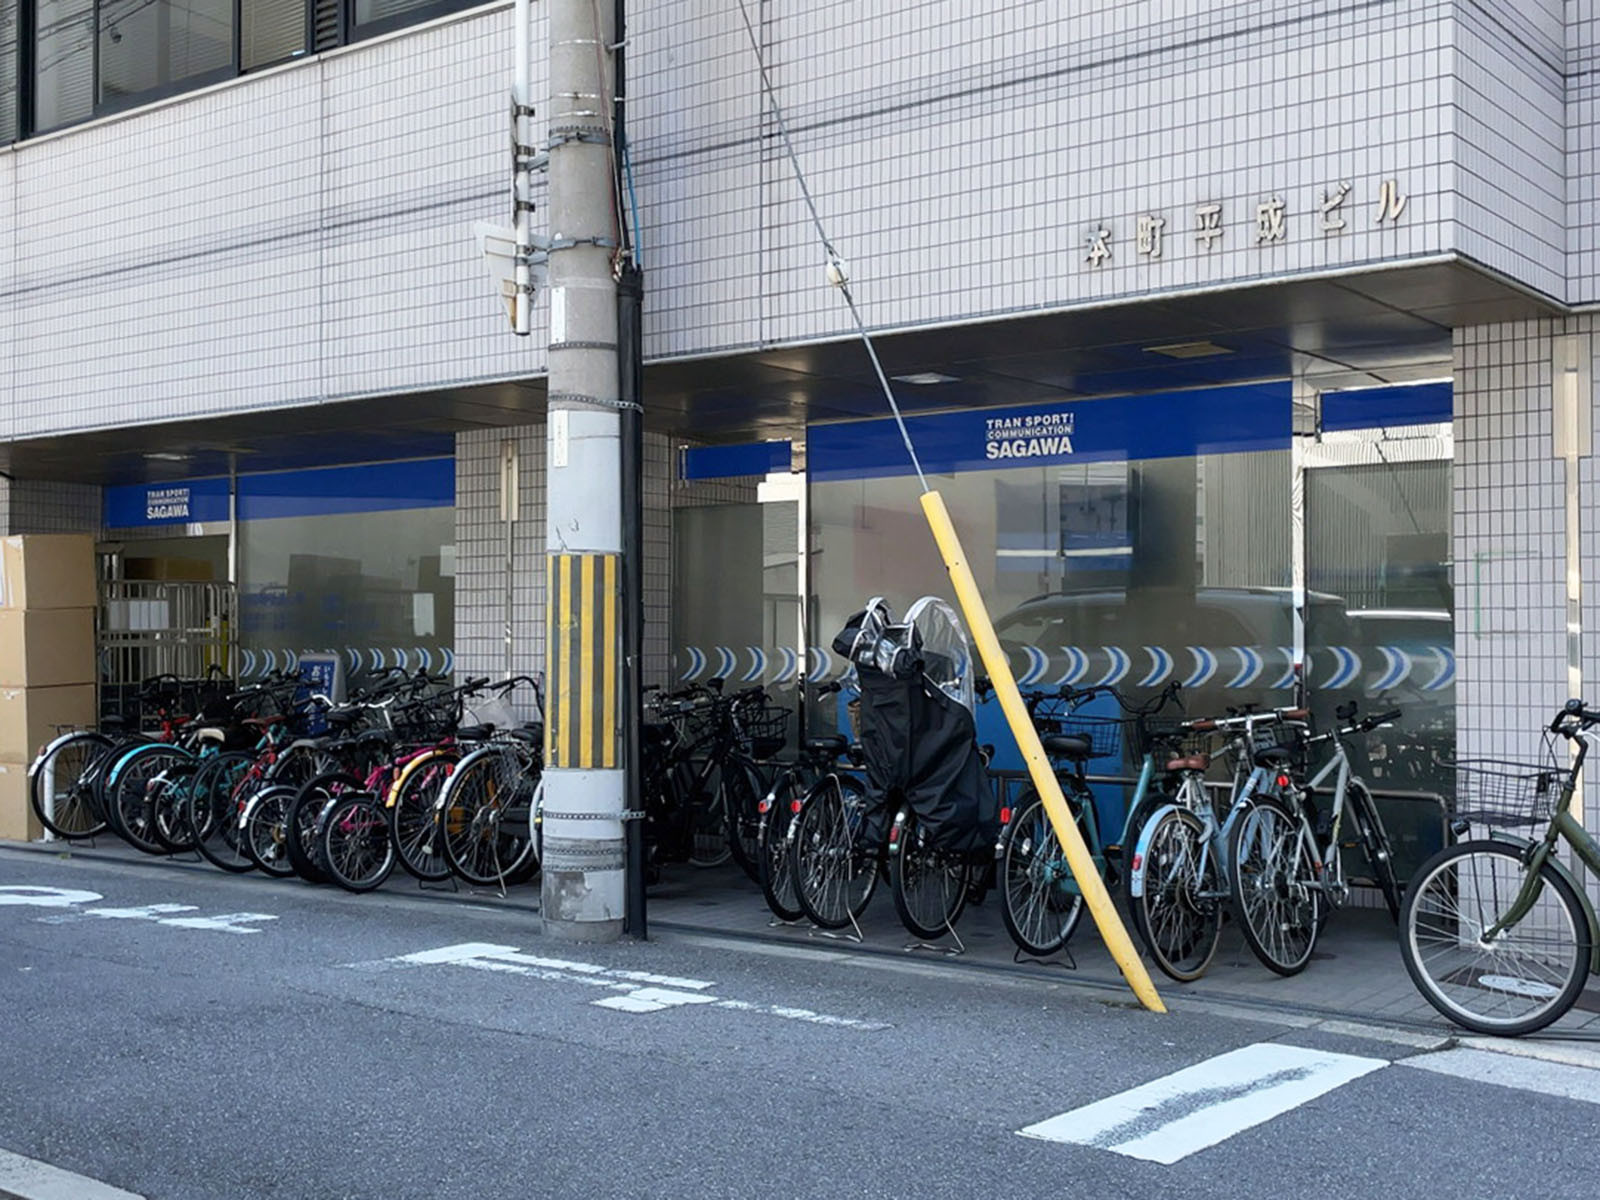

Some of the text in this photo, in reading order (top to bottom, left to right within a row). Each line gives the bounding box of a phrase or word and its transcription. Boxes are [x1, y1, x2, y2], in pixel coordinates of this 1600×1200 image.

[1085, 179, 1408, 267] 本町平成ビル
[987, 424, 1073, 440] COMMUNICATION
[986, 436, 1073, 460] SAGAWA
[147, 505, 189, 519] SAGAWA
